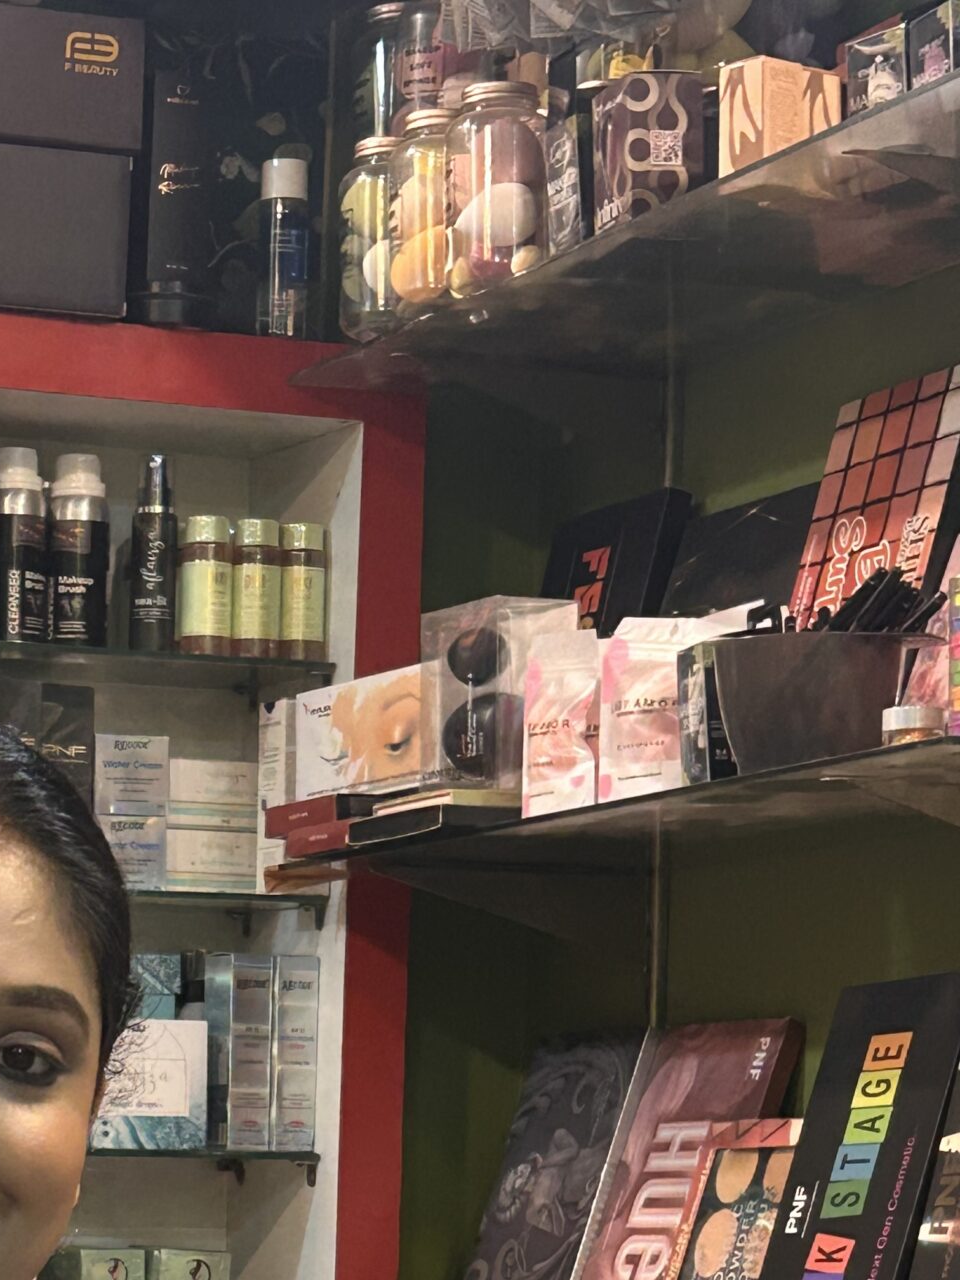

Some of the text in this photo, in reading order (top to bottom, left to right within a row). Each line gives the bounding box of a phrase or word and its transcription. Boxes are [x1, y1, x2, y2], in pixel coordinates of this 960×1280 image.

[749, 1037, 771, 1082] PNF
[830, 1043, 905, 1208] STAGE
[887, 1136, 915, 1212] Cosmetic
[784, 1186, 809, 1234] PNF
